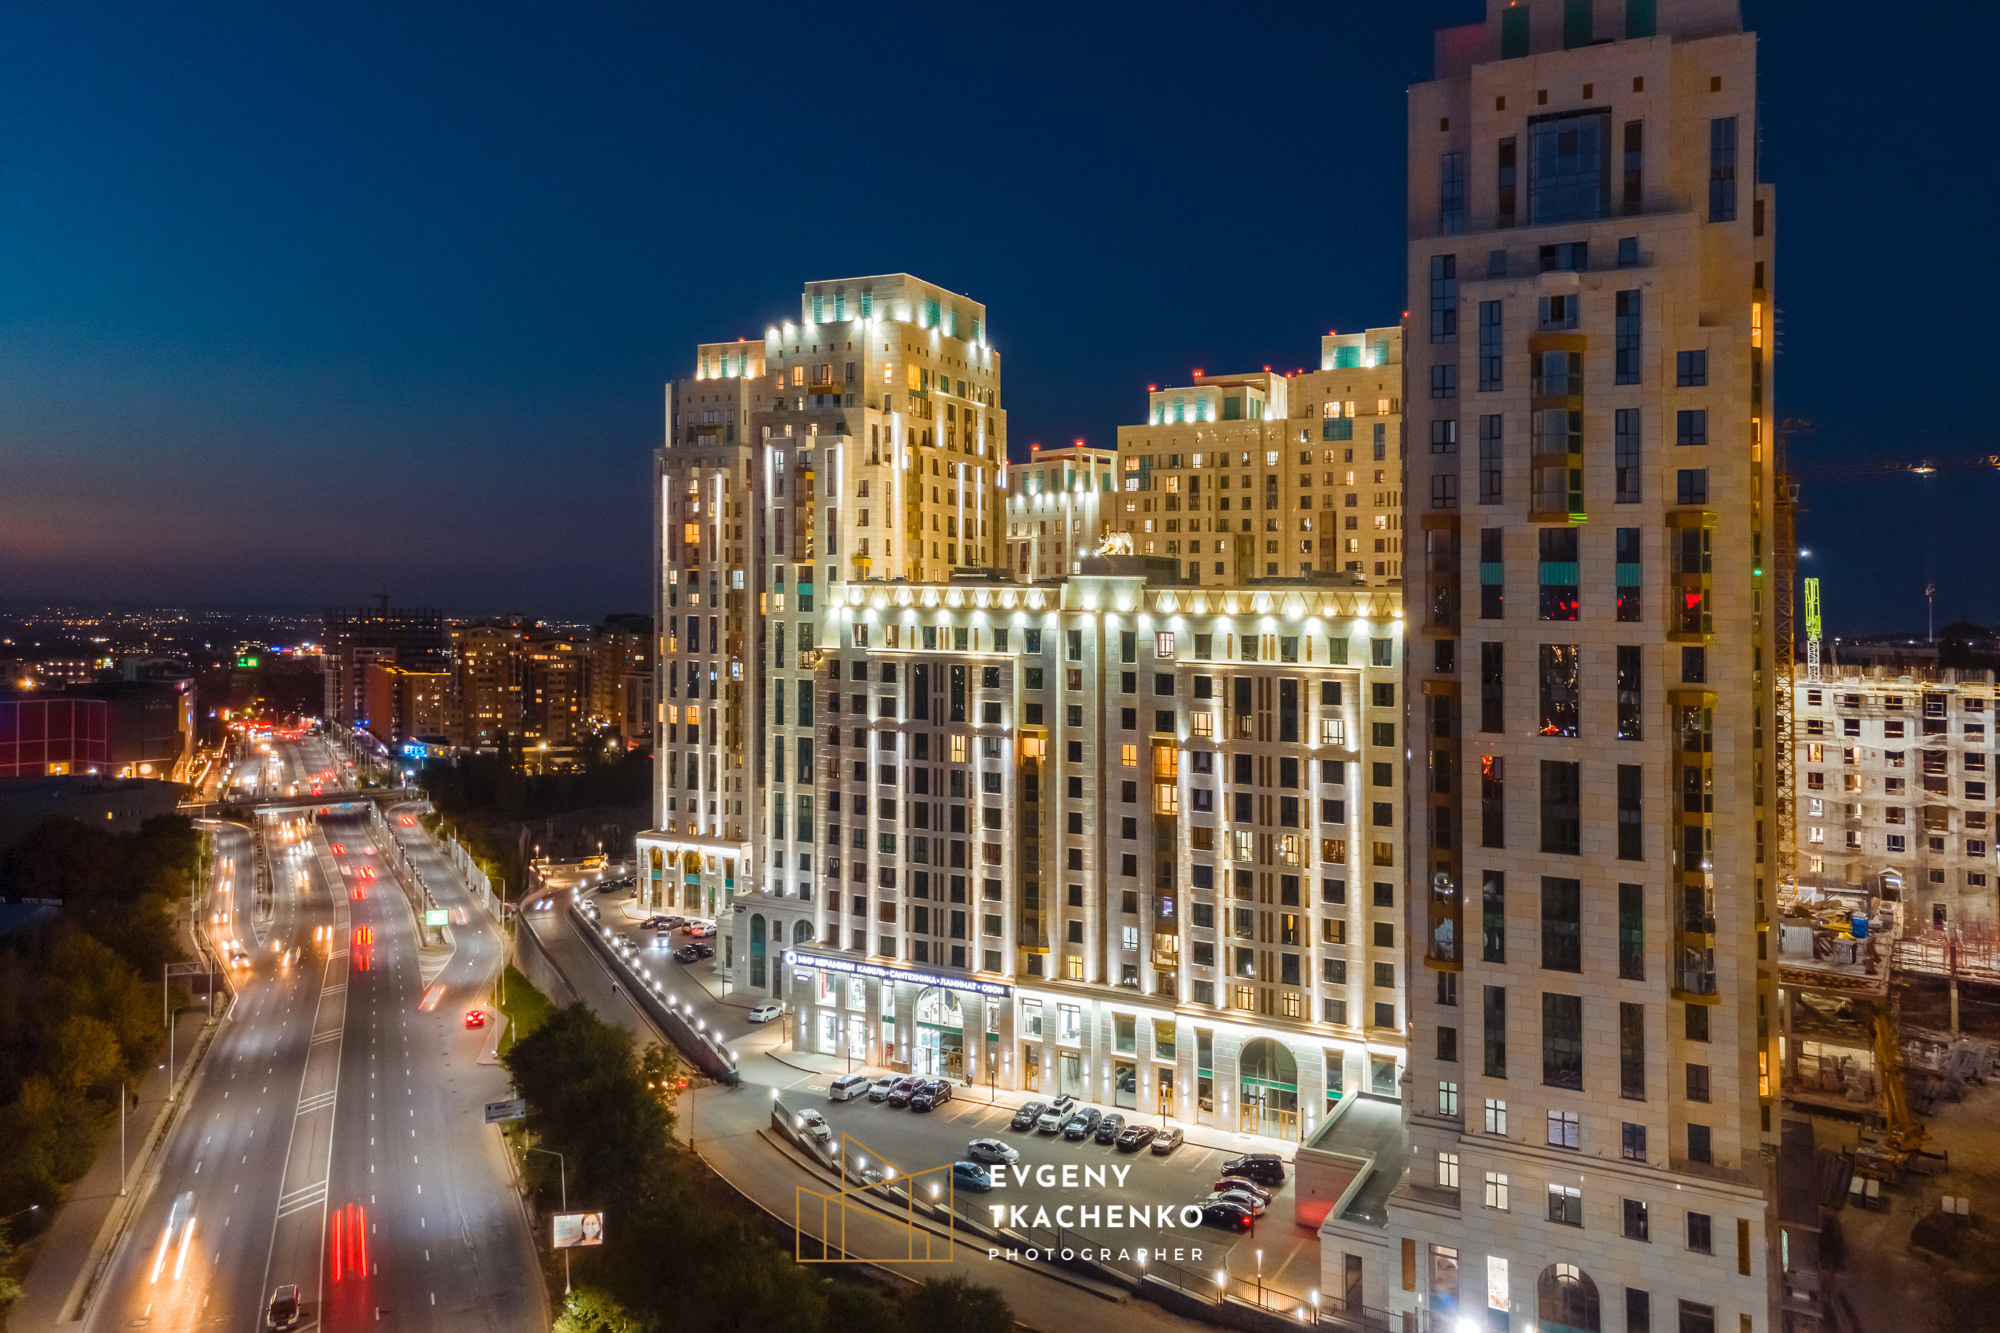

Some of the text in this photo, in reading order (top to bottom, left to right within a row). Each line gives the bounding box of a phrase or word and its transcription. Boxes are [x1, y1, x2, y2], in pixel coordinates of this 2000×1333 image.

[798, 955, 814, 965] МИР
[815, 957, 854, 971] КЕРАМИКИ
[857, 965, 885, 976] КАФЕЛЬ
[890, 970, 936, 984] САНТЕХНИКА
[940, 978, 977, 990] ЛАМИНАТ
